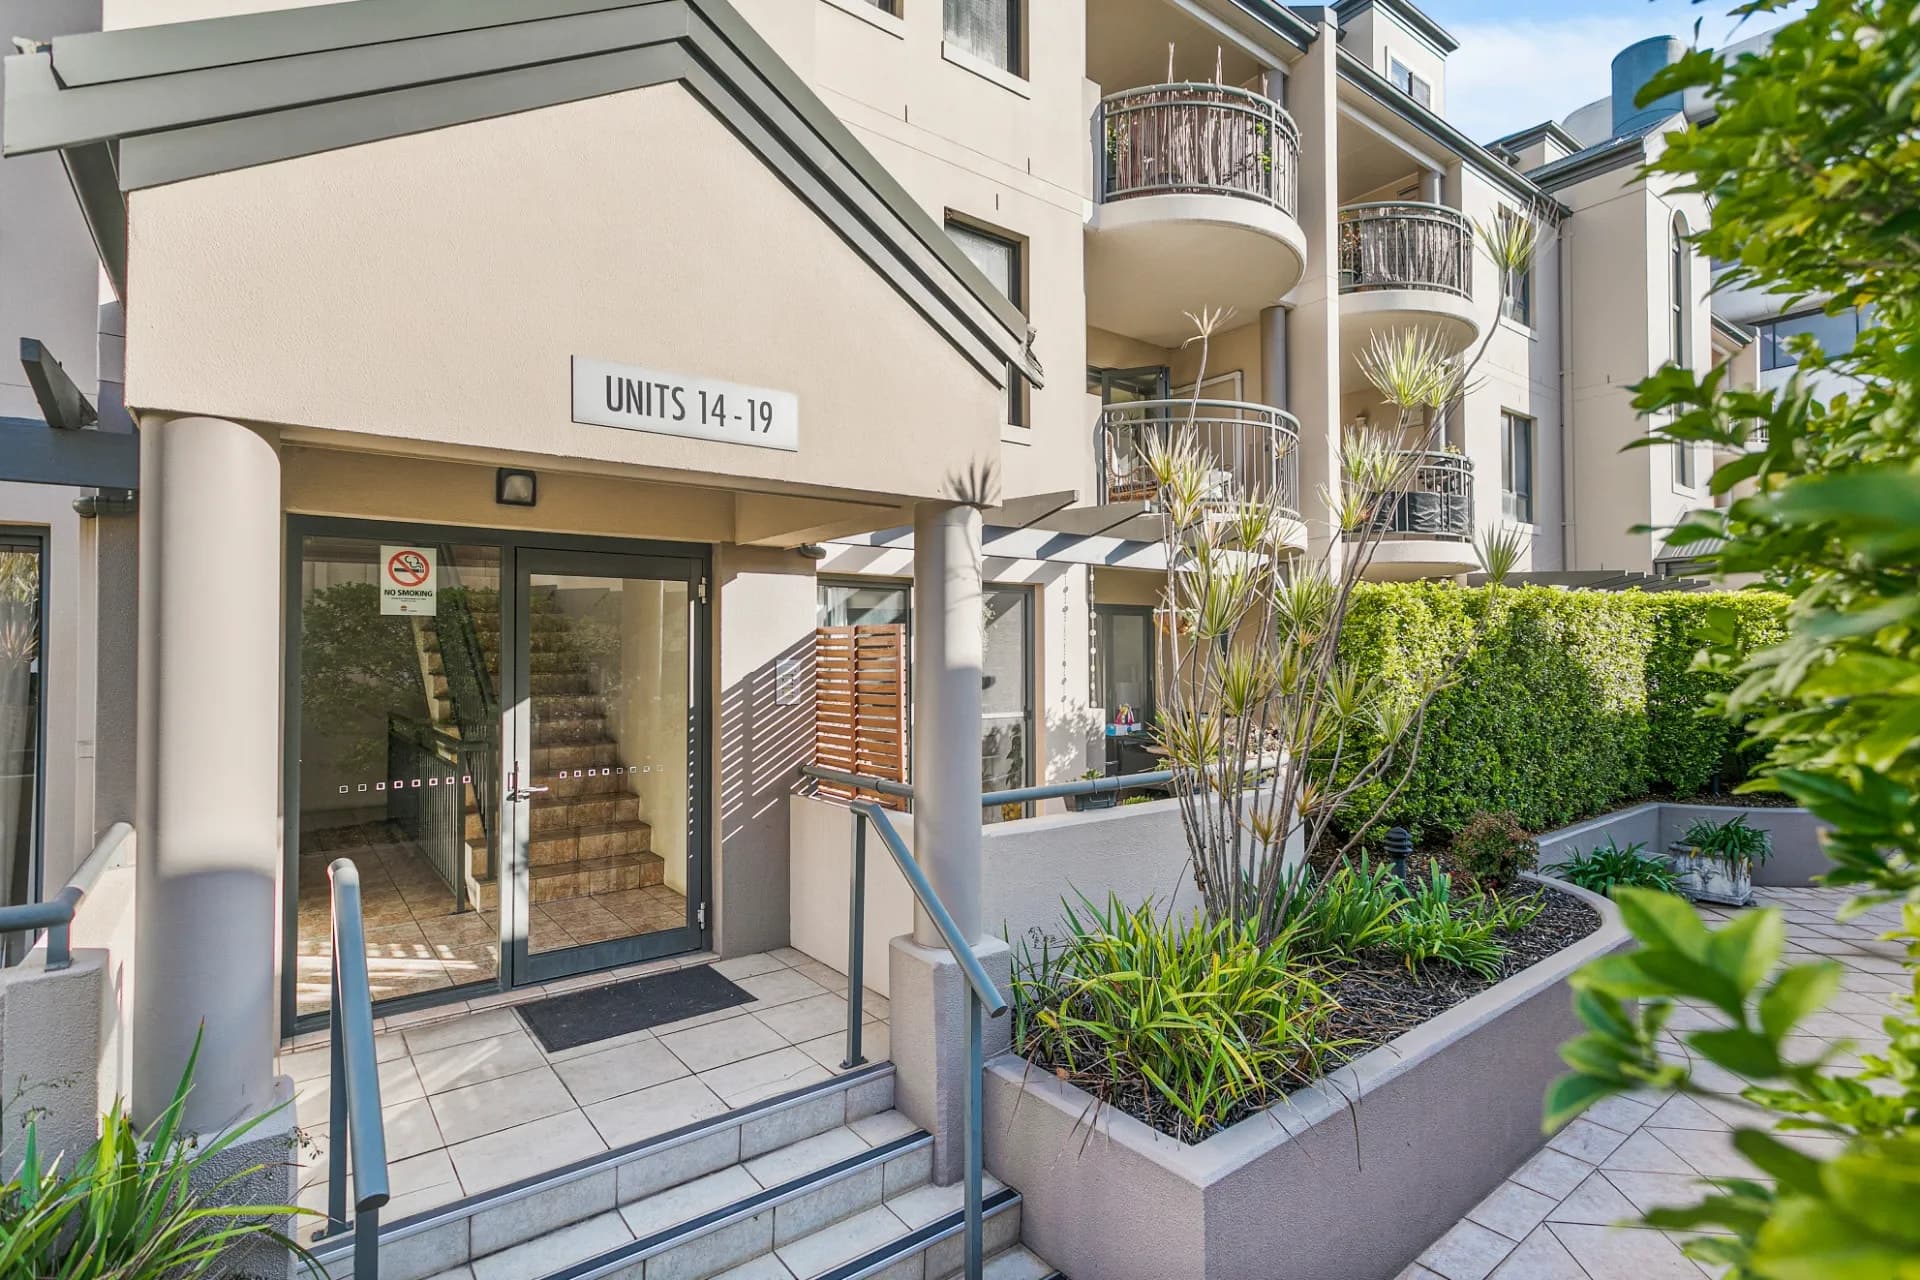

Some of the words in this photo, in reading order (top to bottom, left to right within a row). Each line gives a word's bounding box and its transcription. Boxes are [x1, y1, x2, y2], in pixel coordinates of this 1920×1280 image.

[606, 375, 686, 421] UNITS
[698, 390, 773, 433] 14-19
[397, 589, 433, 597] SMOKING
